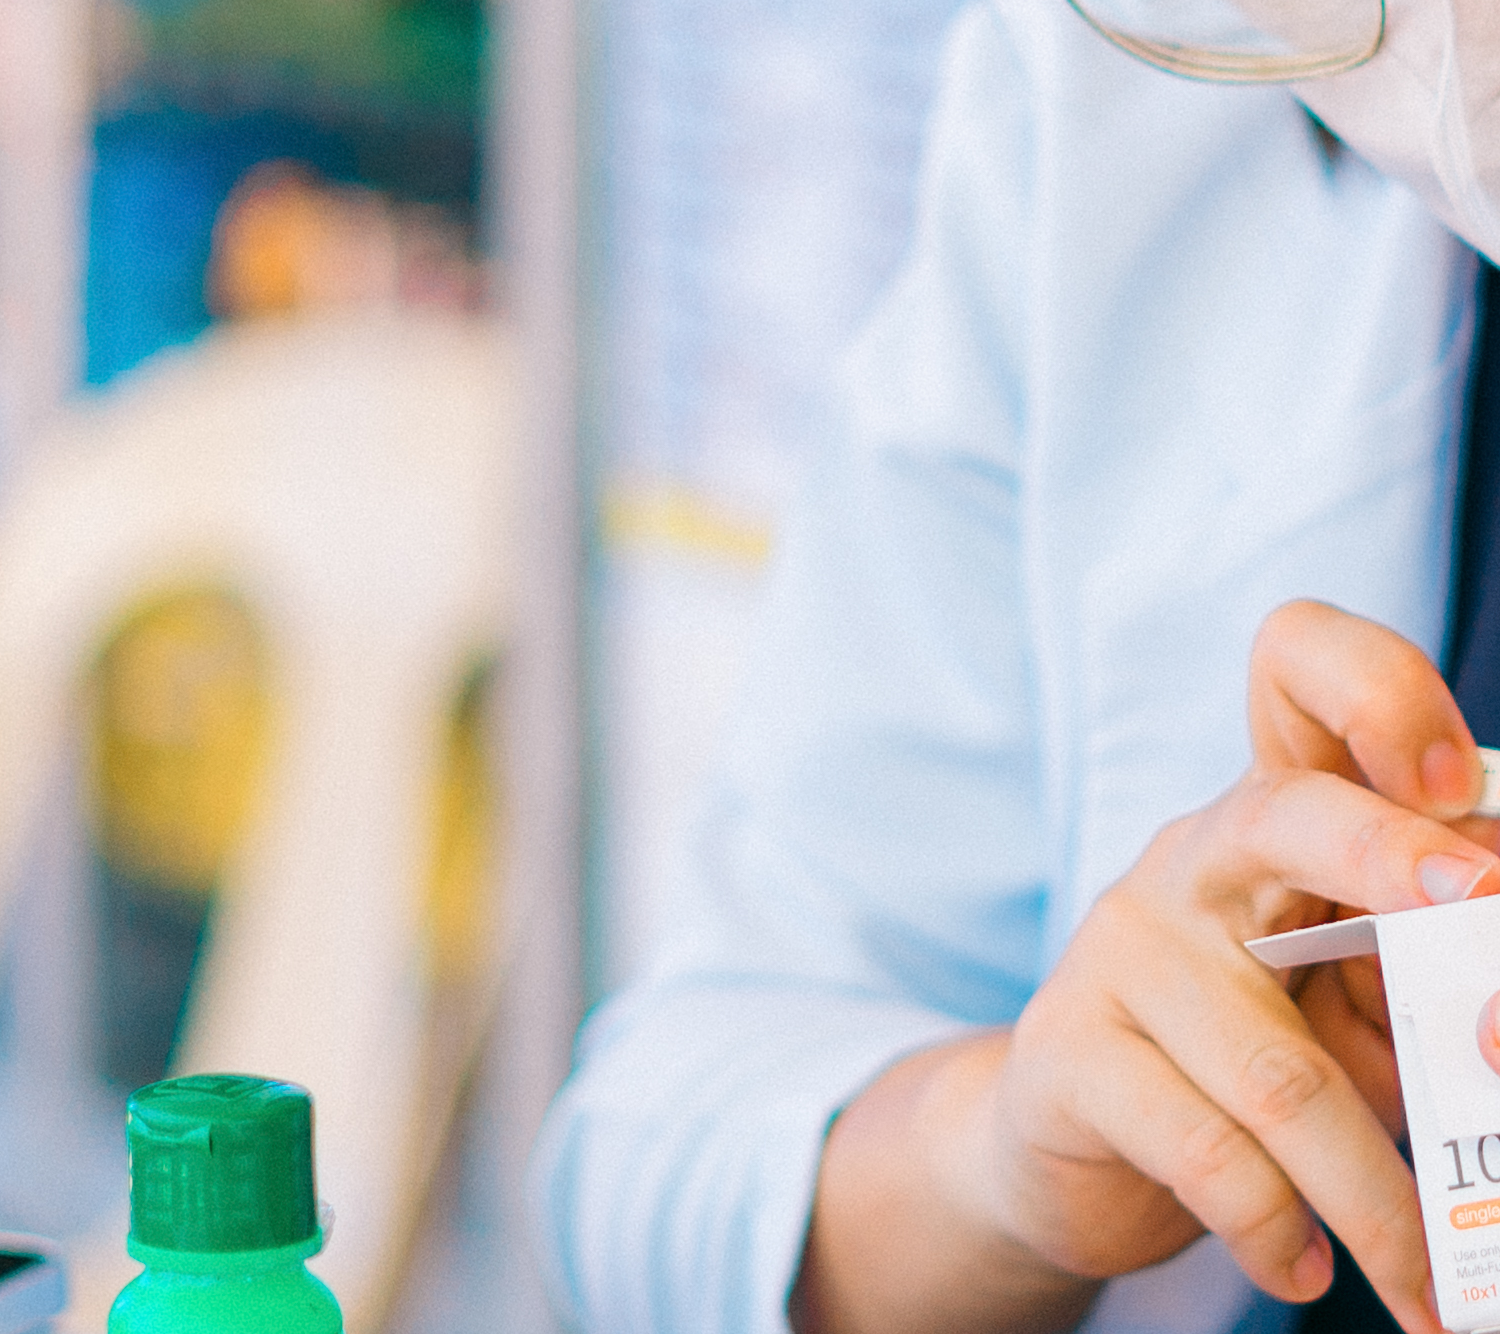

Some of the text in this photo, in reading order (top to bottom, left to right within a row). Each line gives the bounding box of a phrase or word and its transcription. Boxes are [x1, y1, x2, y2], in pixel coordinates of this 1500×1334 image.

[1456, 1204, 1500, 1225] single
[1454, 1249, 1477, 1263] Use
[1461, 1284, 1497, 1302] 10x1
